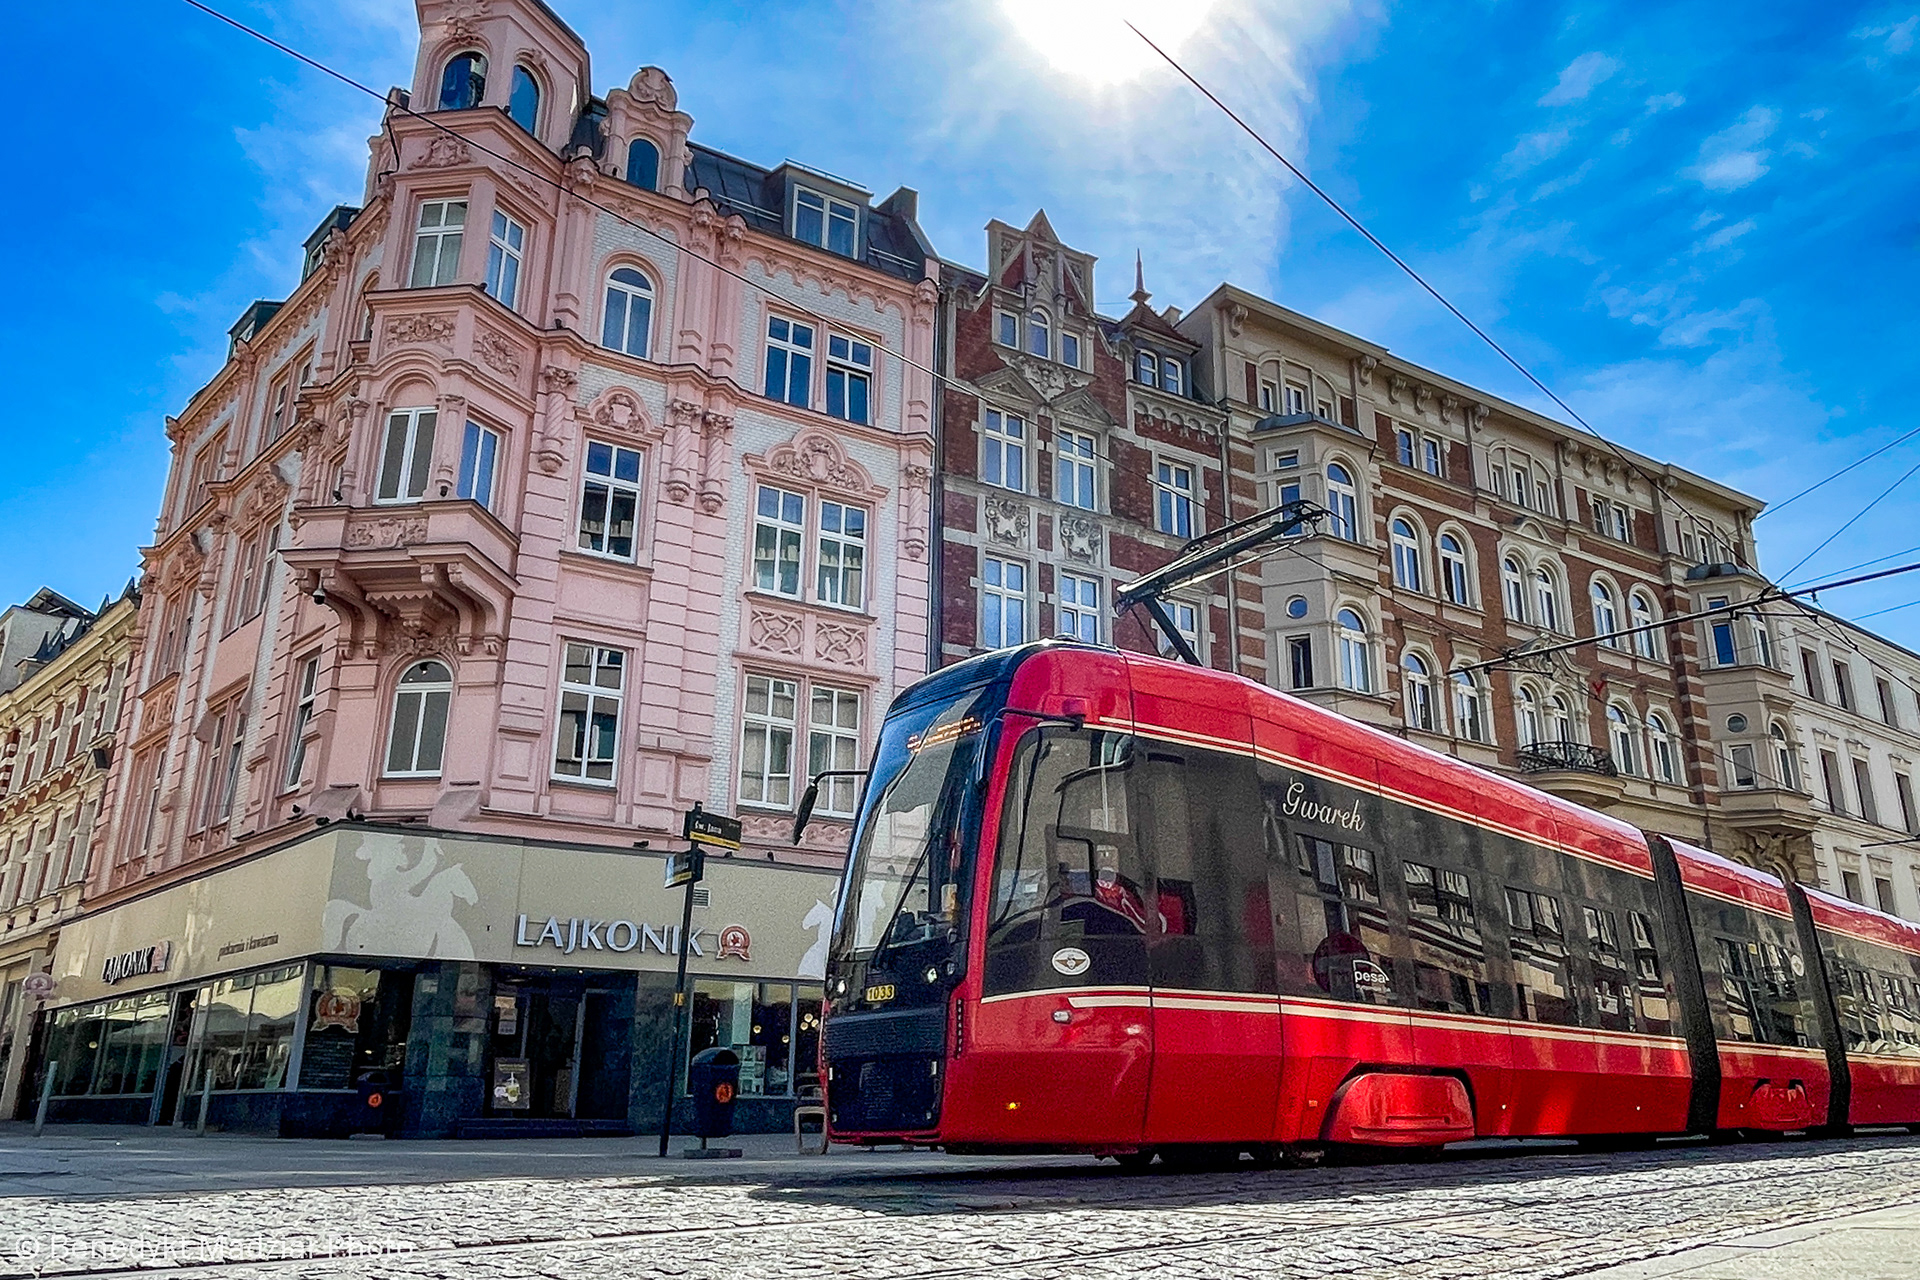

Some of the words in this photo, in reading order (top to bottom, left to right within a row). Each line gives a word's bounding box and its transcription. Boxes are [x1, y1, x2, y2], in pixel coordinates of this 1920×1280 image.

[1282, 777, 1365, 832] Gwarek
[516, 913, 704, 957] LAJKONIK
[102, 946, 155, 985] LAJKONIK
[1354, 971, 1387, 984] pesa
[868, 985, 893, 1000] 1033
